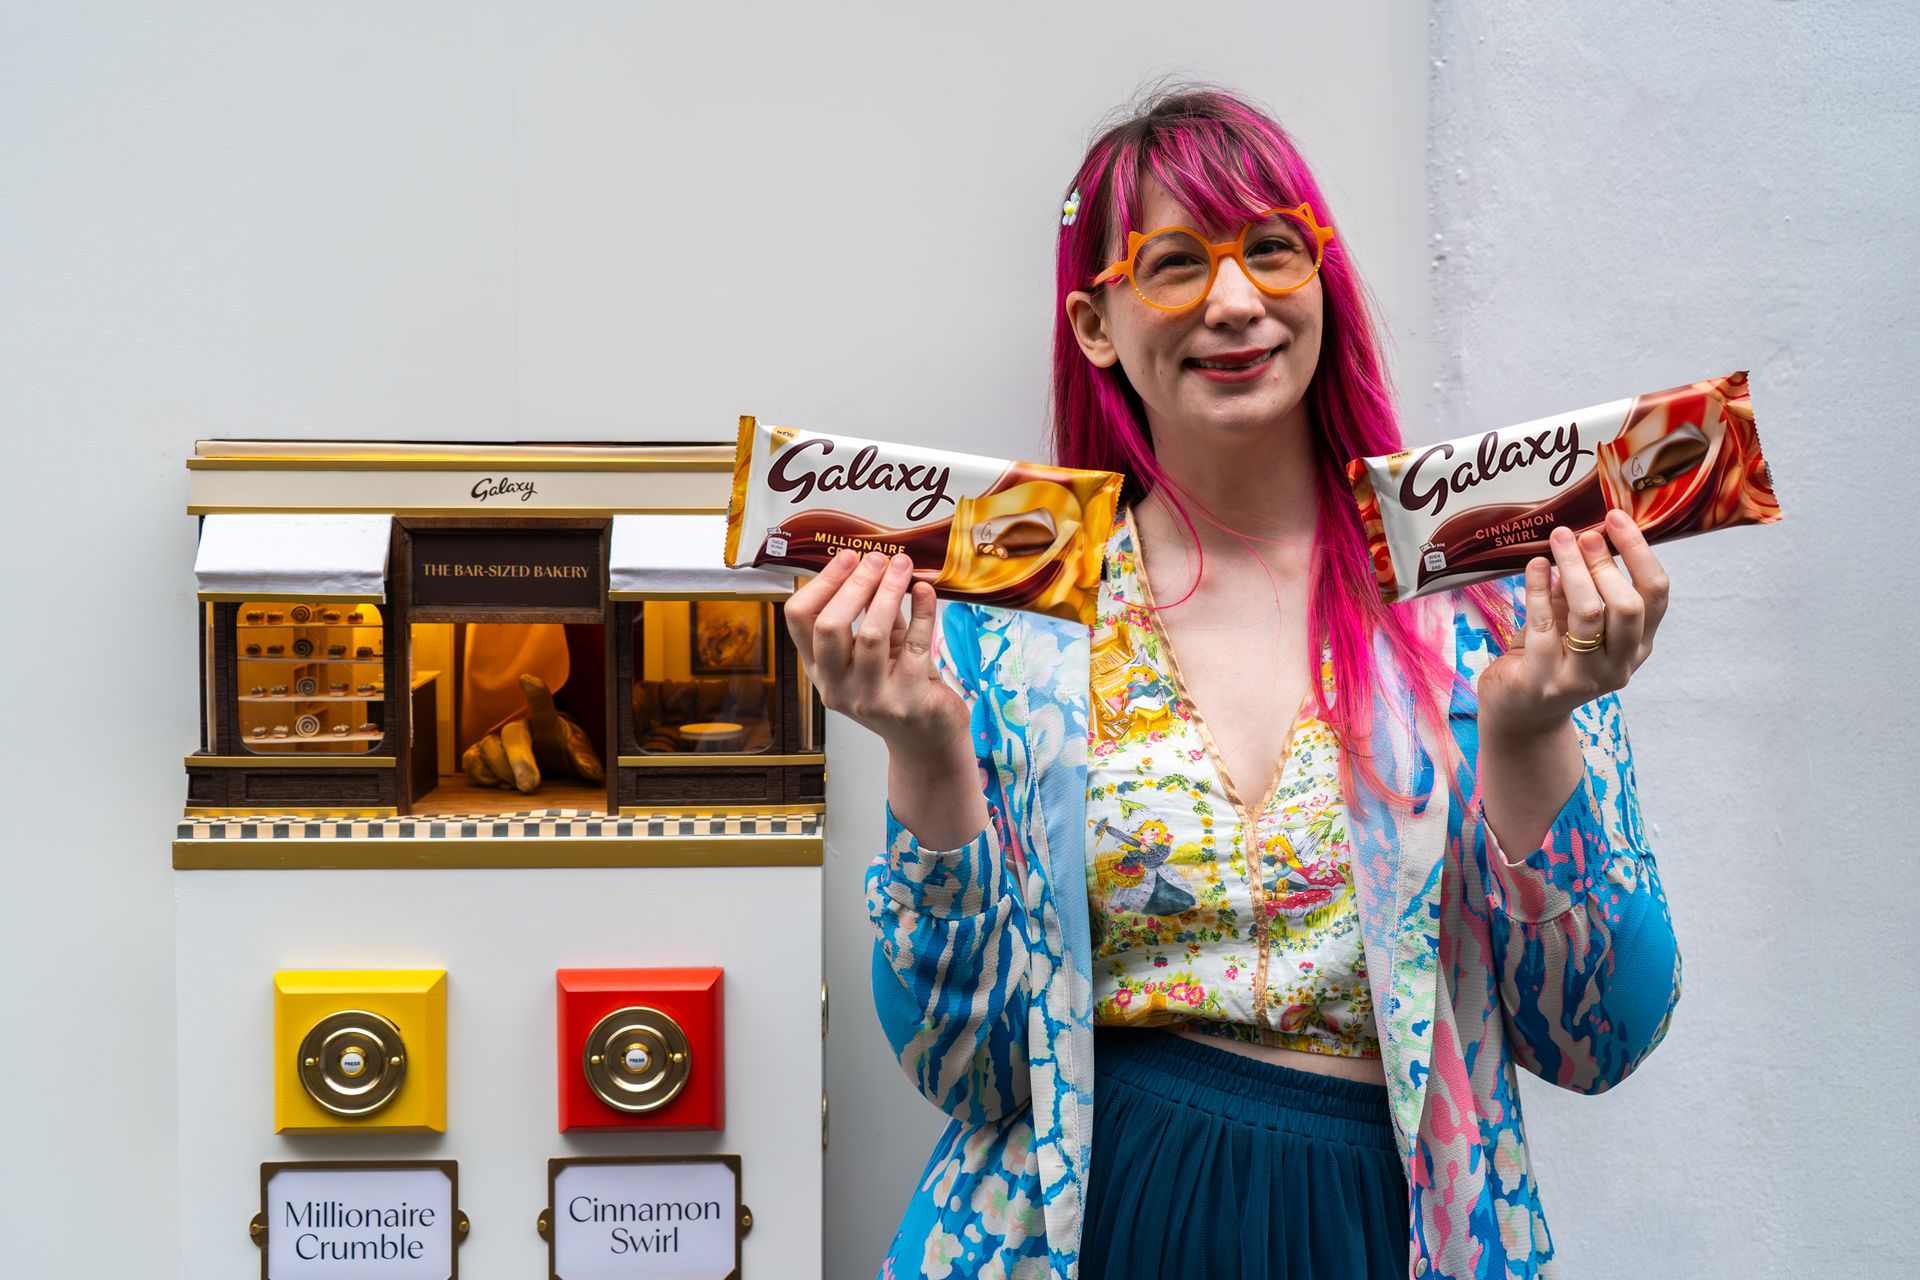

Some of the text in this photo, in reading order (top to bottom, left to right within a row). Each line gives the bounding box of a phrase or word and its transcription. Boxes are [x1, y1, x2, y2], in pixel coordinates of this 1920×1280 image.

[767, 438, 955, 521] Galaxy
[1399, 422, 1595, 517] Galaxy
[470, 477, 538, 502] Galaxy
[1475, 512, 1555, 540] CINNAMON
[1495, 529, 1539, 547] SWIRL
[814, 532, 906, 554] MILLIONAIRE
[422, 564, 591, 578] THE BAR-SIZED BAKERY
[286, 1201, 435, 1228] Millionaire
[569, 1195, 720, 1223] Cinnamon
[296, 1233, 424, 1260] Crumble
[611, 1226, 678, 1254] Swirl
